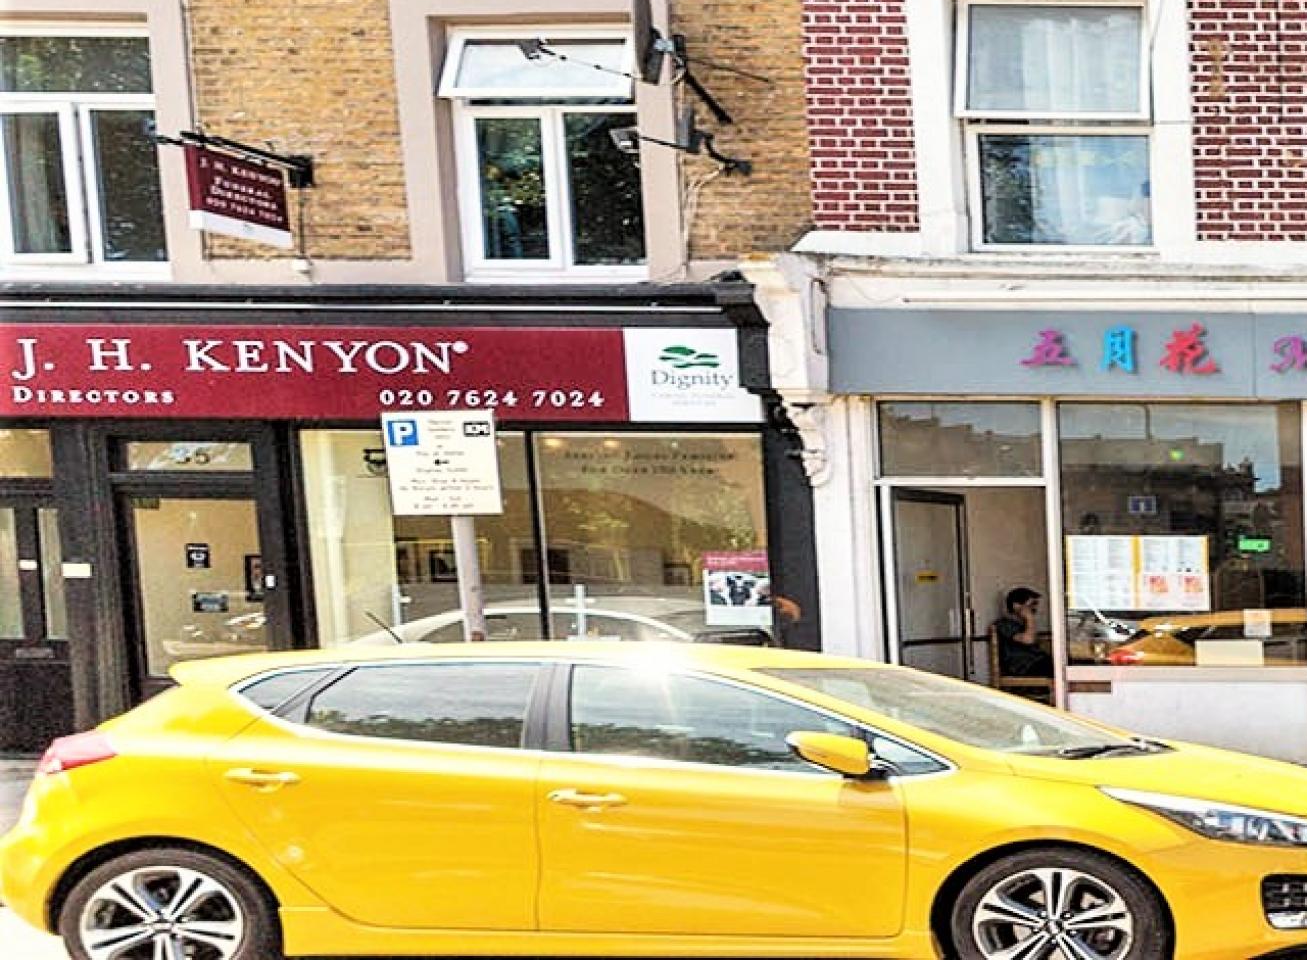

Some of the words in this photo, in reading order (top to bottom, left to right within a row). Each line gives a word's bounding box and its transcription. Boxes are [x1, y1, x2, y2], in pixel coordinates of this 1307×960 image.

[11, 338, 55, 381] J.
[85, 338, 152, 371] H.
[650, 369, 734, 391] Dignity
[11, 386, 175, 404] DIRECTORS
[379, 389, 433, 406] 020
[446, 390, 519, 408] 7624
[531, 390, 605, 408] 7024
[391, 422, 413, 445] P
